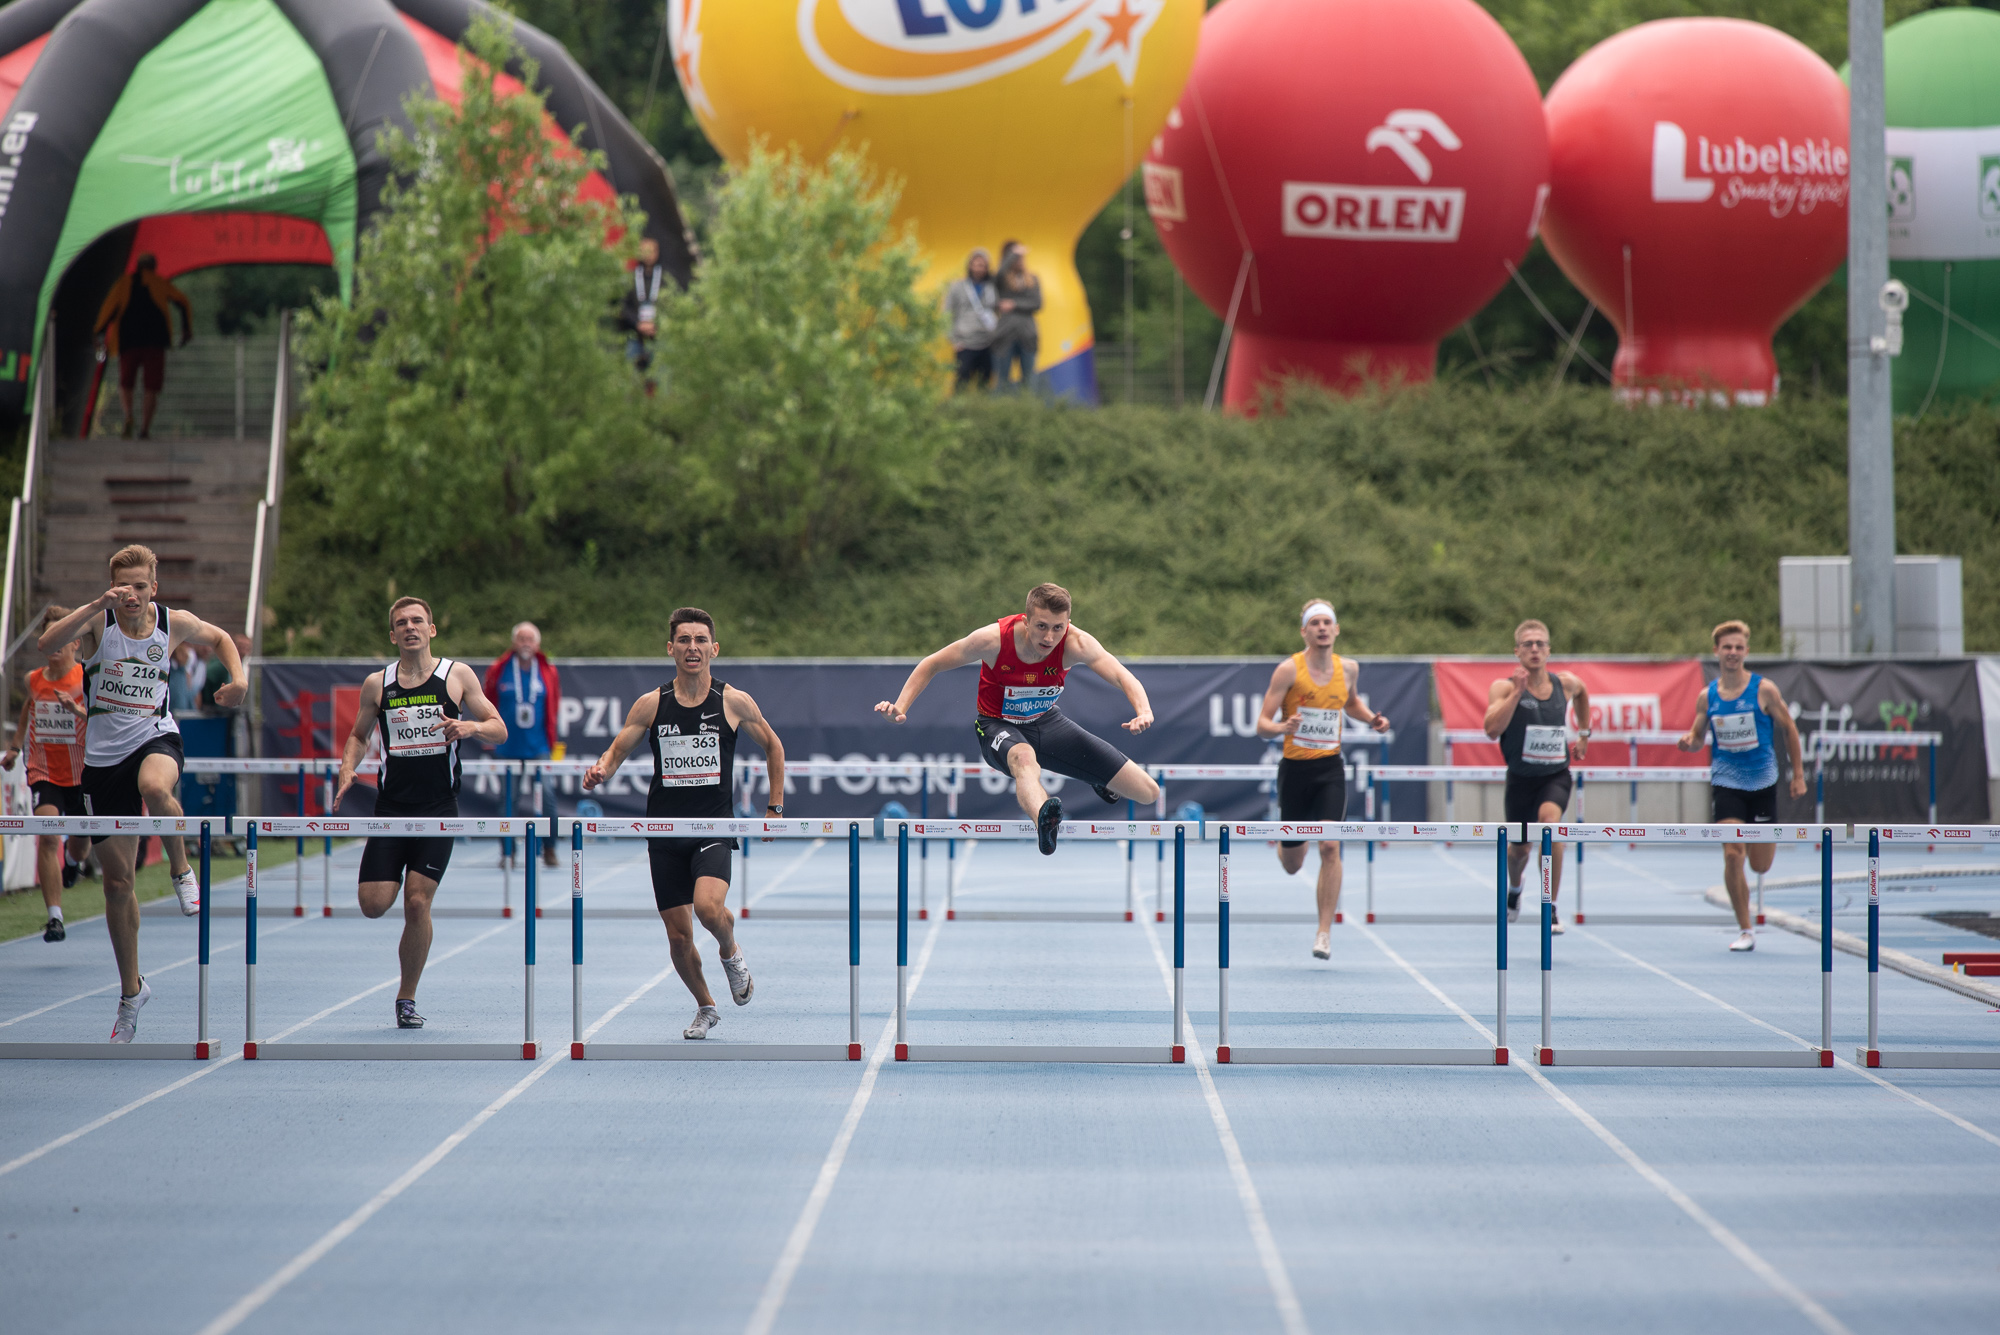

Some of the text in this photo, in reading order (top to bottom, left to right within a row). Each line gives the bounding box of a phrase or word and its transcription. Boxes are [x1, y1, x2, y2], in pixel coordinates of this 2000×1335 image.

[1296, 194, 1450, 232] ORLEN
[132, 666, 156, 679] 216
[100, 680, 154, 698] JOŃCZYK
[388, 695, 438, 707] WKS WAWEL
[106, 704, 126, 713] LUBLIN
[416, 708, 440, 720] 354
[35, 718, 74, 729] SZRAJNER
[397, 724, 436, 740] KOPEĆ
[692, 737, 716, 748] 363
[664, 756, 718, 768] STOKŁOSA
[808, 752, 967, 796] POLSKI
